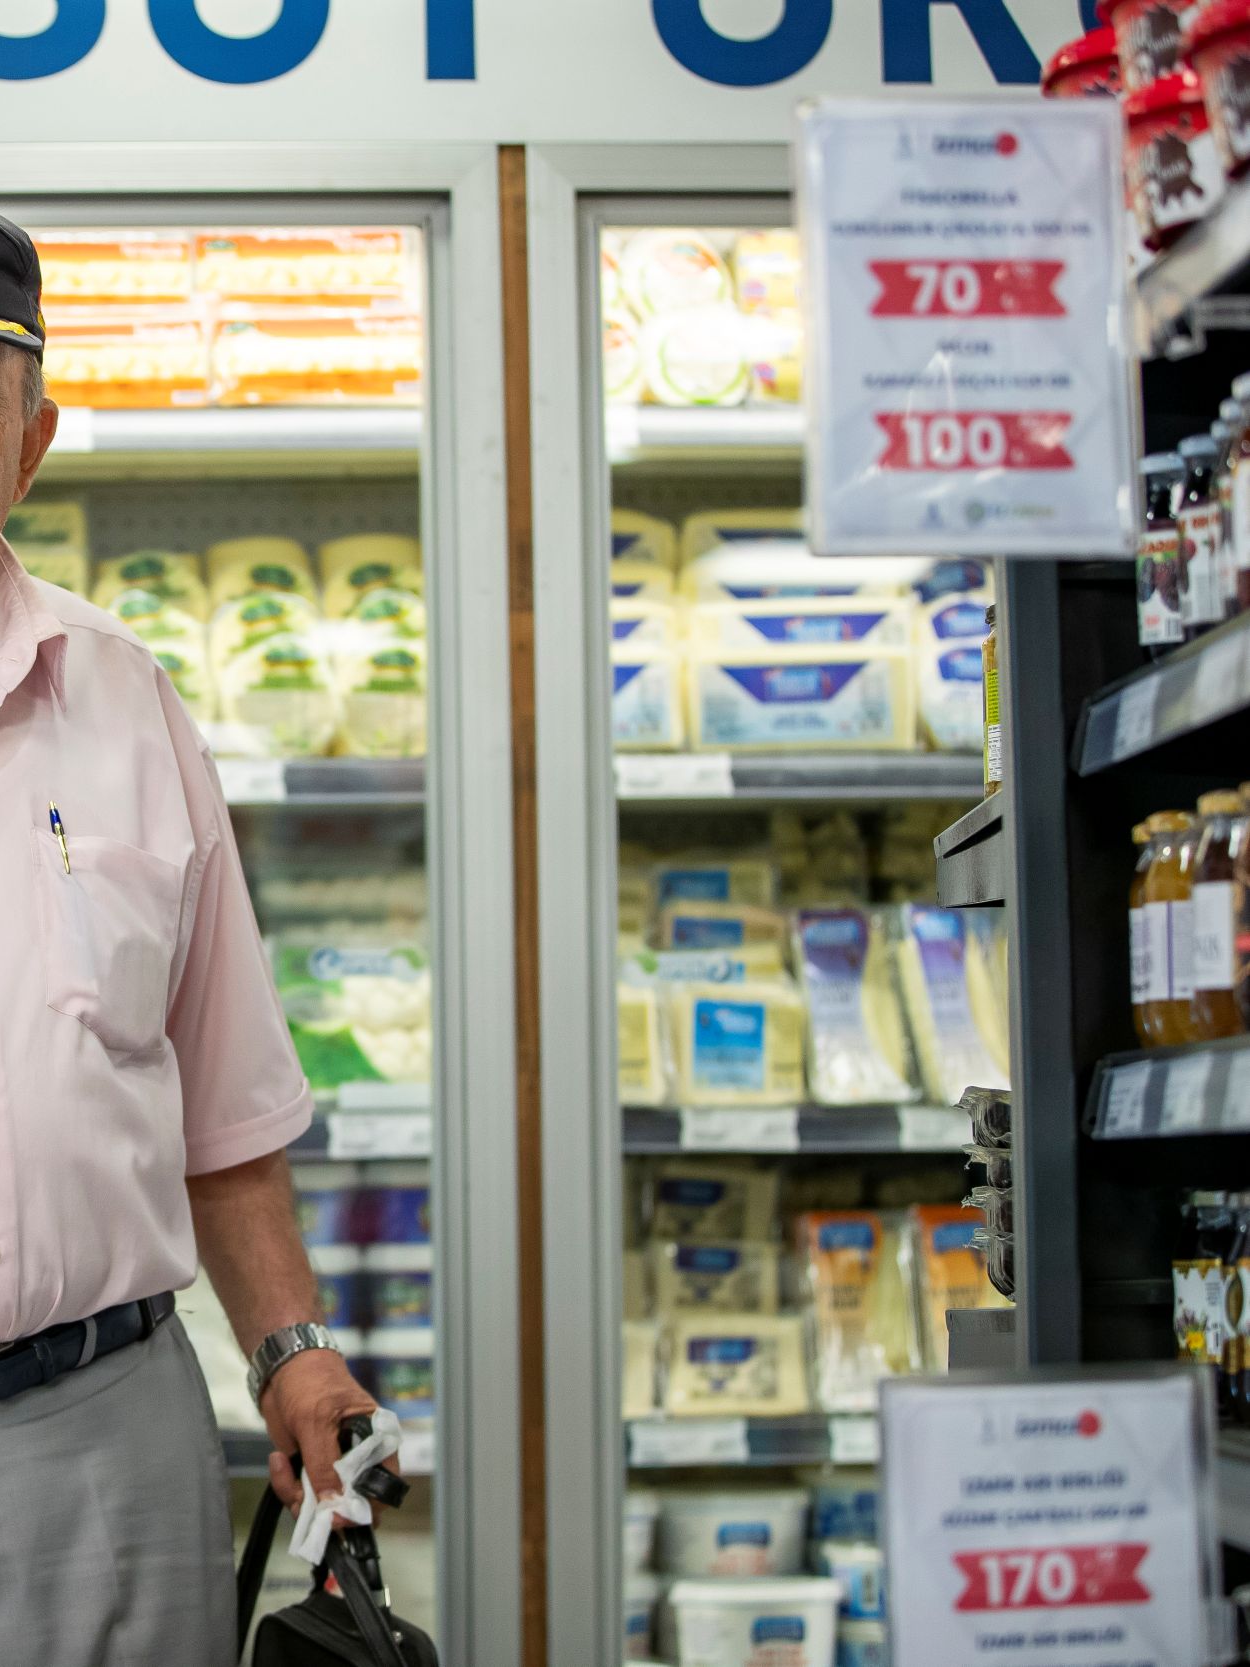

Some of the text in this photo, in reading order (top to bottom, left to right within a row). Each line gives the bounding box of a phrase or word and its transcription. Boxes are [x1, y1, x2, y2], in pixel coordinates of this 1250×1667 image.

[906, 265, 981, 314] 70
[904, 417, 1005, 467] 100
[980, 1551, 1078, 1609] 170
